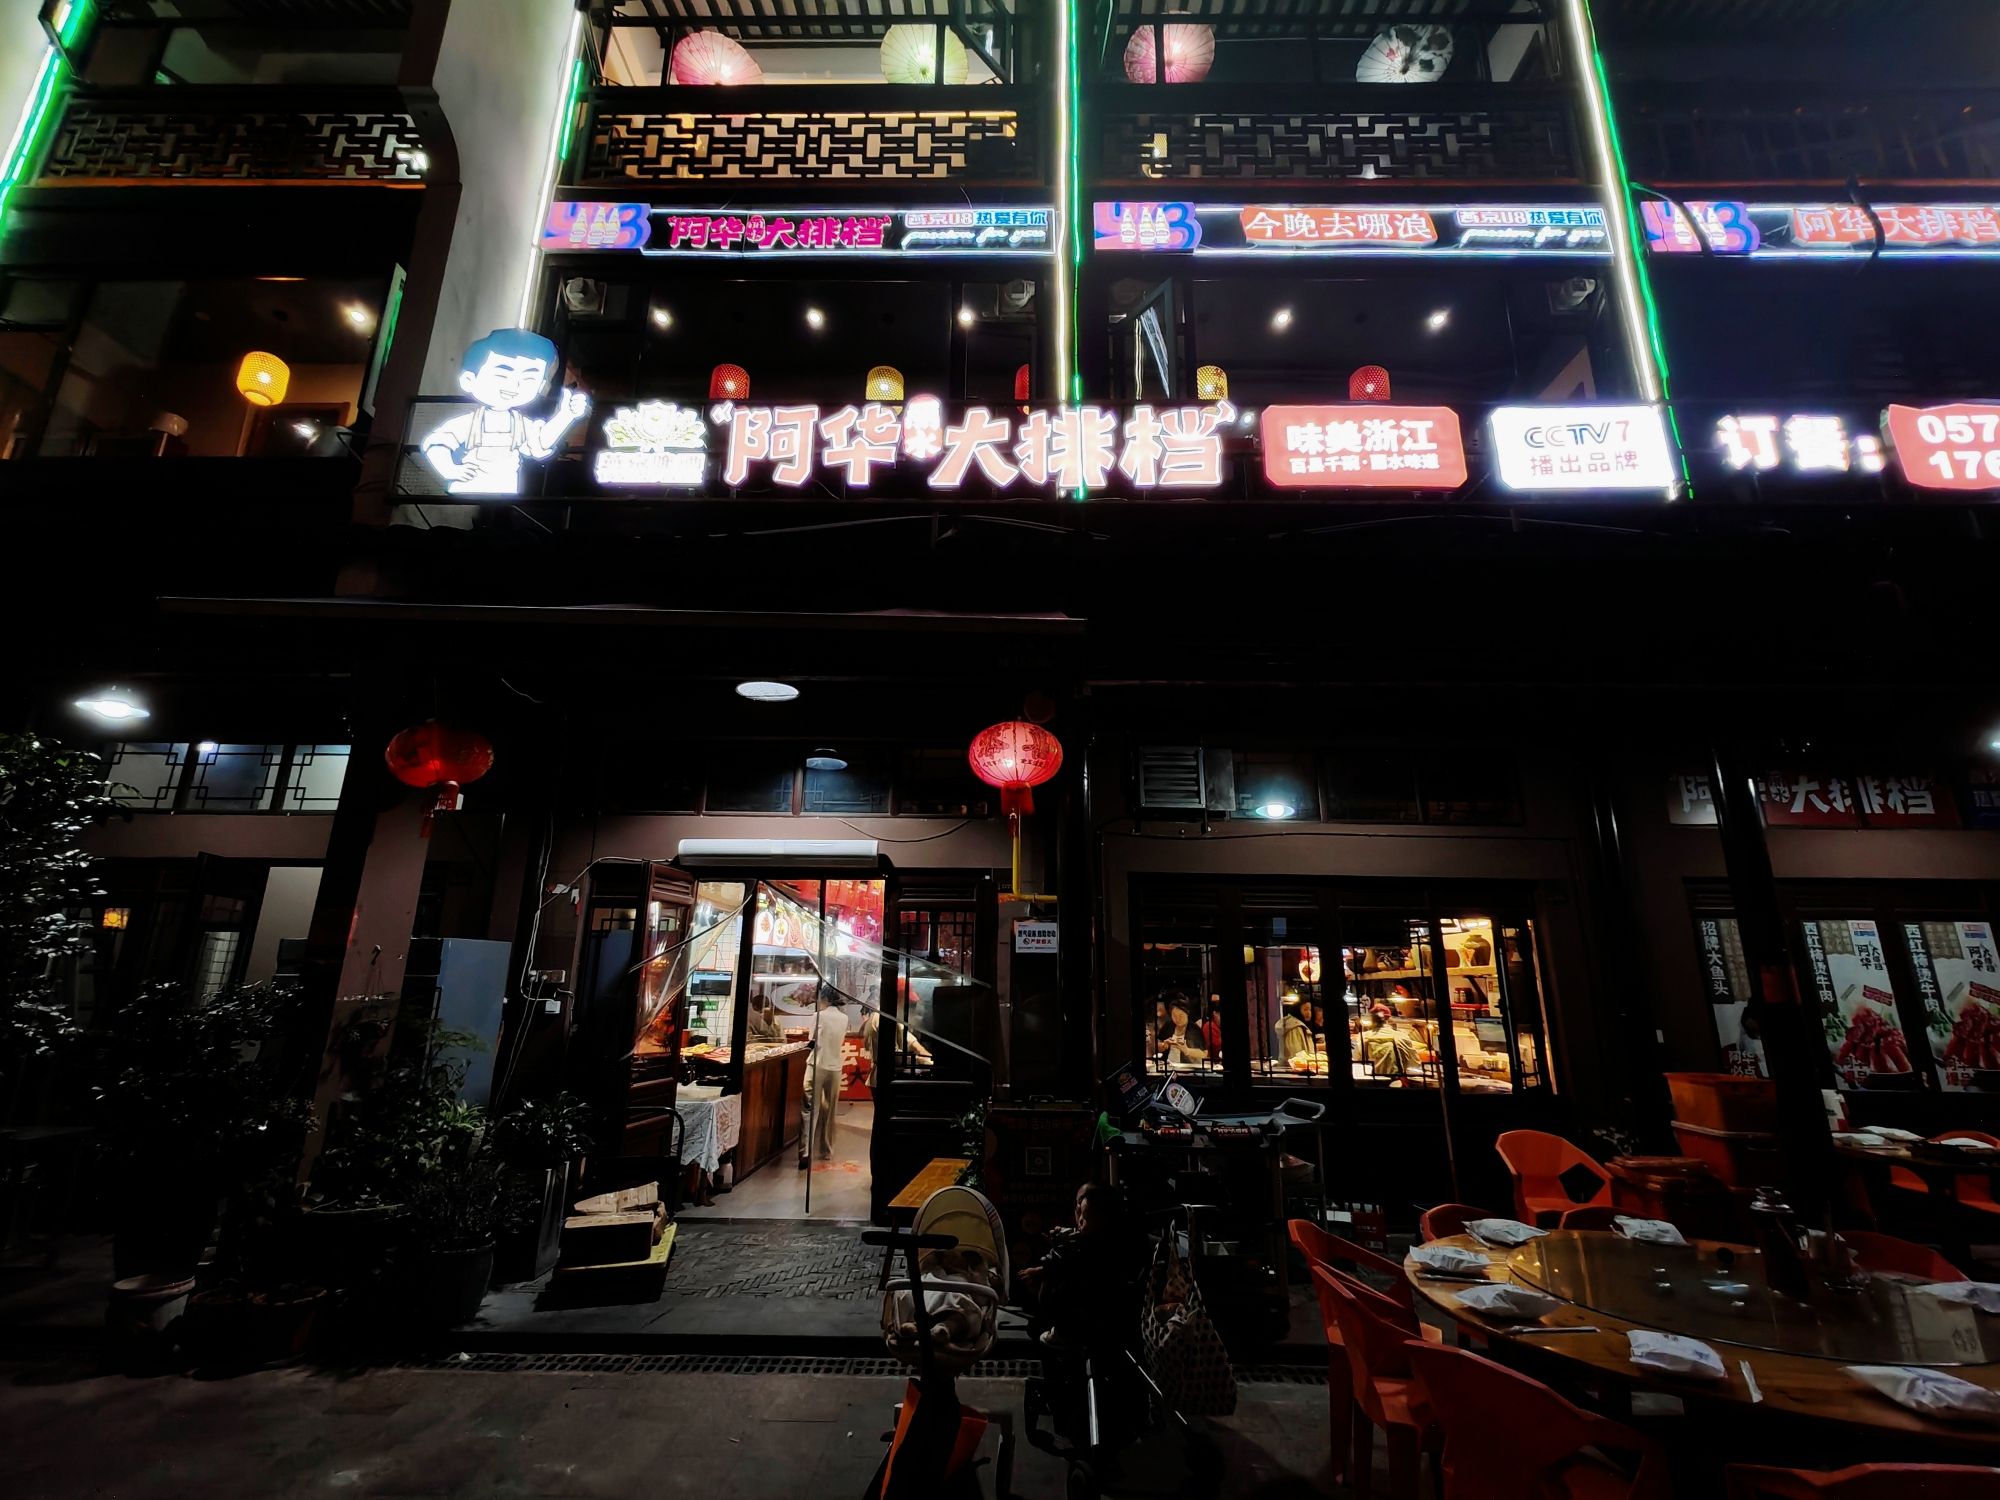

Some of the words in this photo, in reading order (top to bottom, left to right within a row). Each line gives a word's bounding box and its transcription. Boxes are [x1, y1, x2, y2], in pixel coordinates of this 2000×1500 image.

[1245, 211, 1433, 239] 今晚去哪浪
[1797, 209, 2000, 239] 阿华大排档
[1287, 419, 1438, 454] 味美浙江
[1917, 414, 2000, 444] 057
[1530, 451, 1639, 476] 播出品牌
[1701, 920, 1729, 995] 招牌大鱼头
